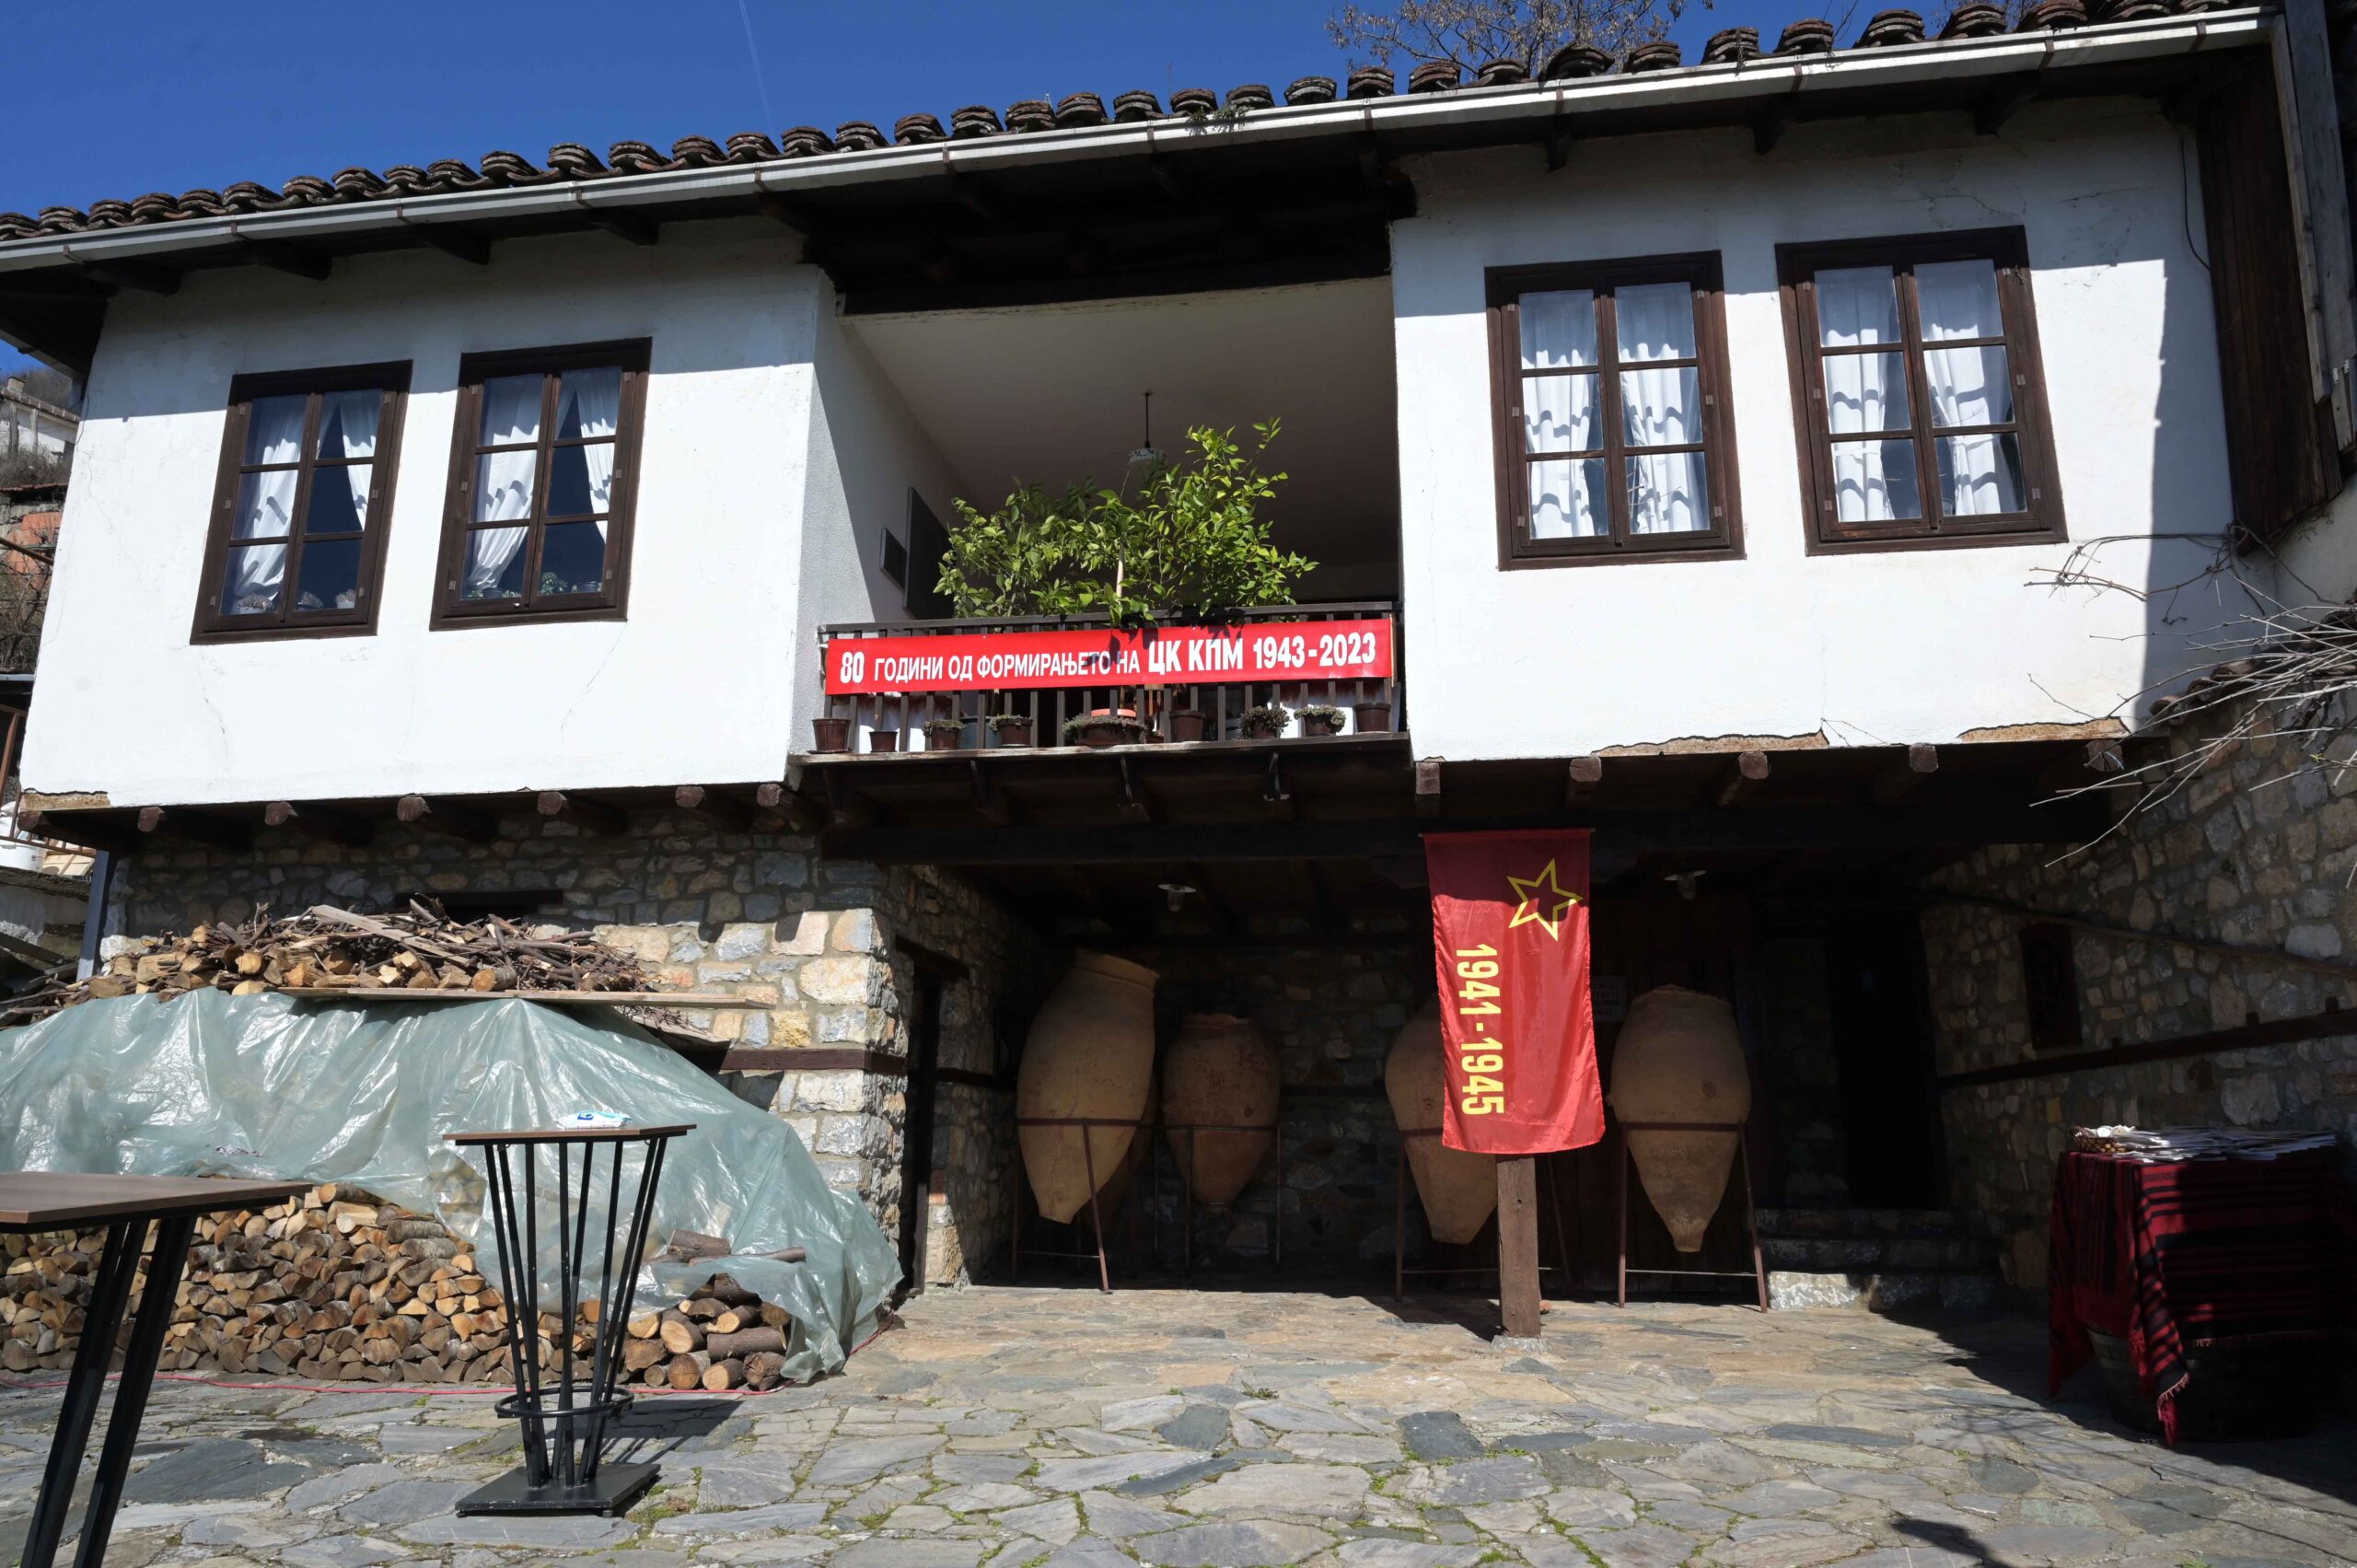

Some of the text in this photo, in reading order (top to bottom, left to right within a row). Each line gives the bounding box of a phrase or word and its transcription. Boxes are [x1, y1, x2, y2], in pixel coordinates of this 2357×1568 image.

[840, 632, 1376, 683] 80 ГОДИНИ ОД ФОРМИРАЊЕТО НА ЦК КПМ 1943-2023
